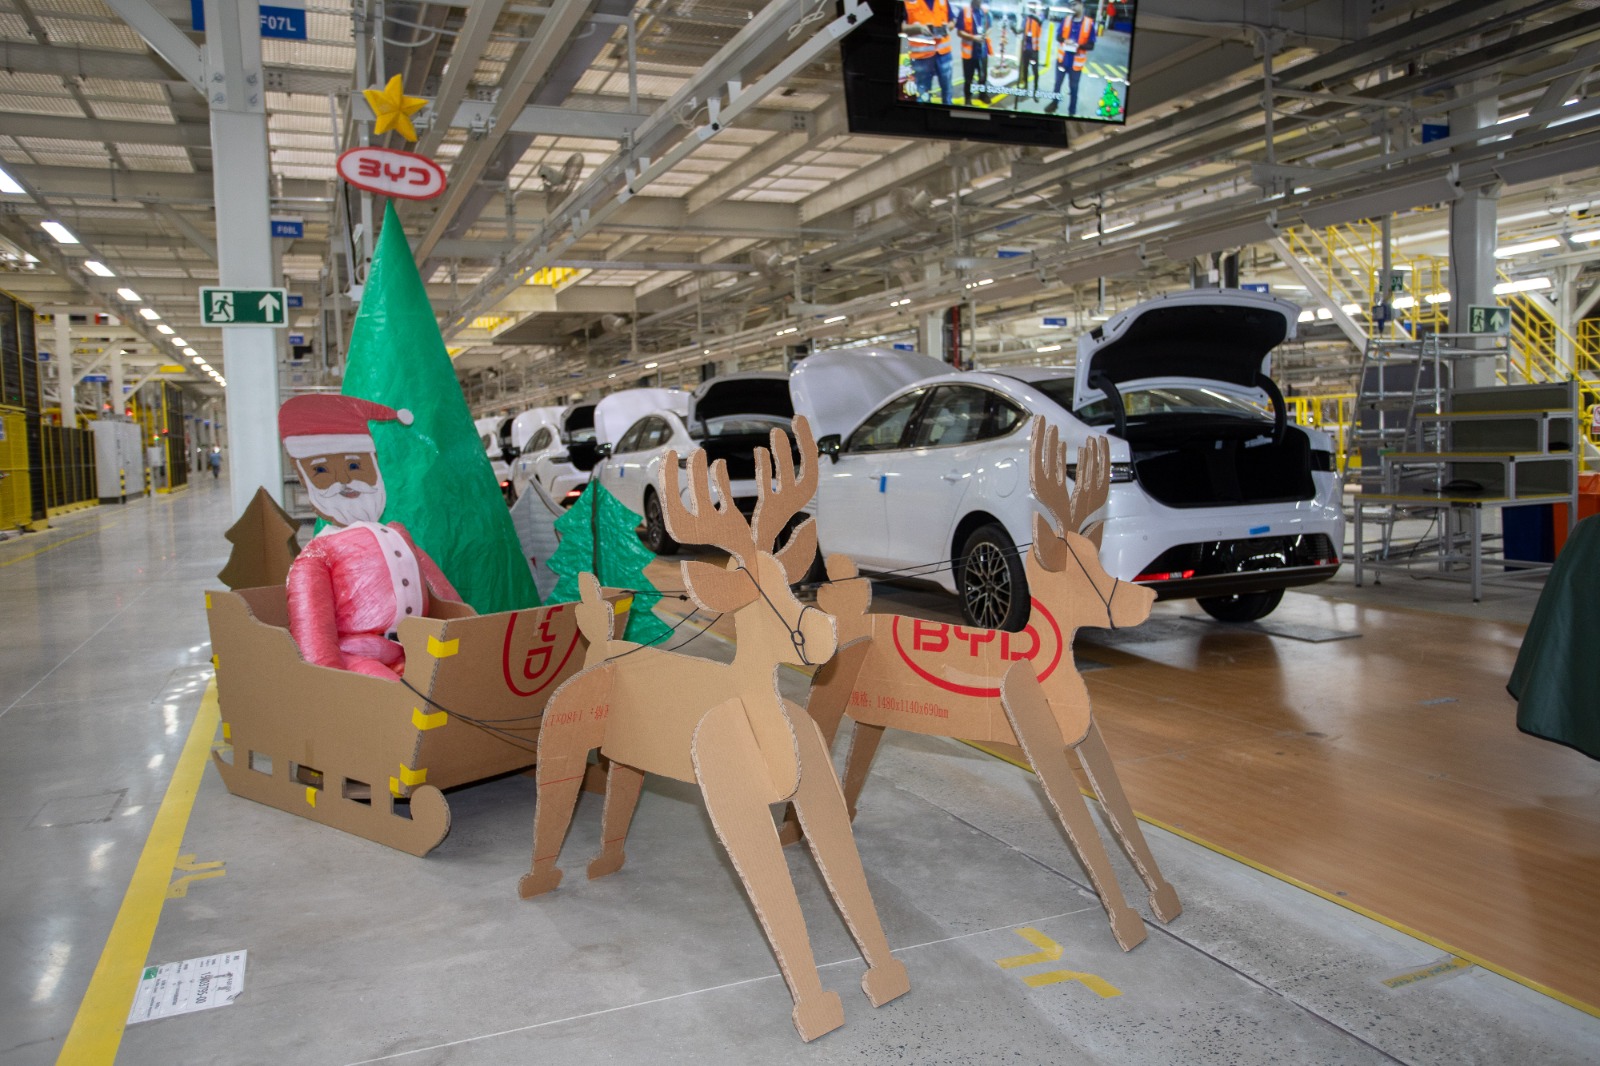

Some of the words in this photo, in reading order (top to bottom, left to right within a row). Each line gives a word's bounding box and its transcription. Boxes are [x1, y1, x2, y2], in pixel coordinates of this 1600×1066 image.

[260, 15, 297, 32] F07L
[358, 157, 432, 187] BYD
[913, 619, 1041, 662] BYD
